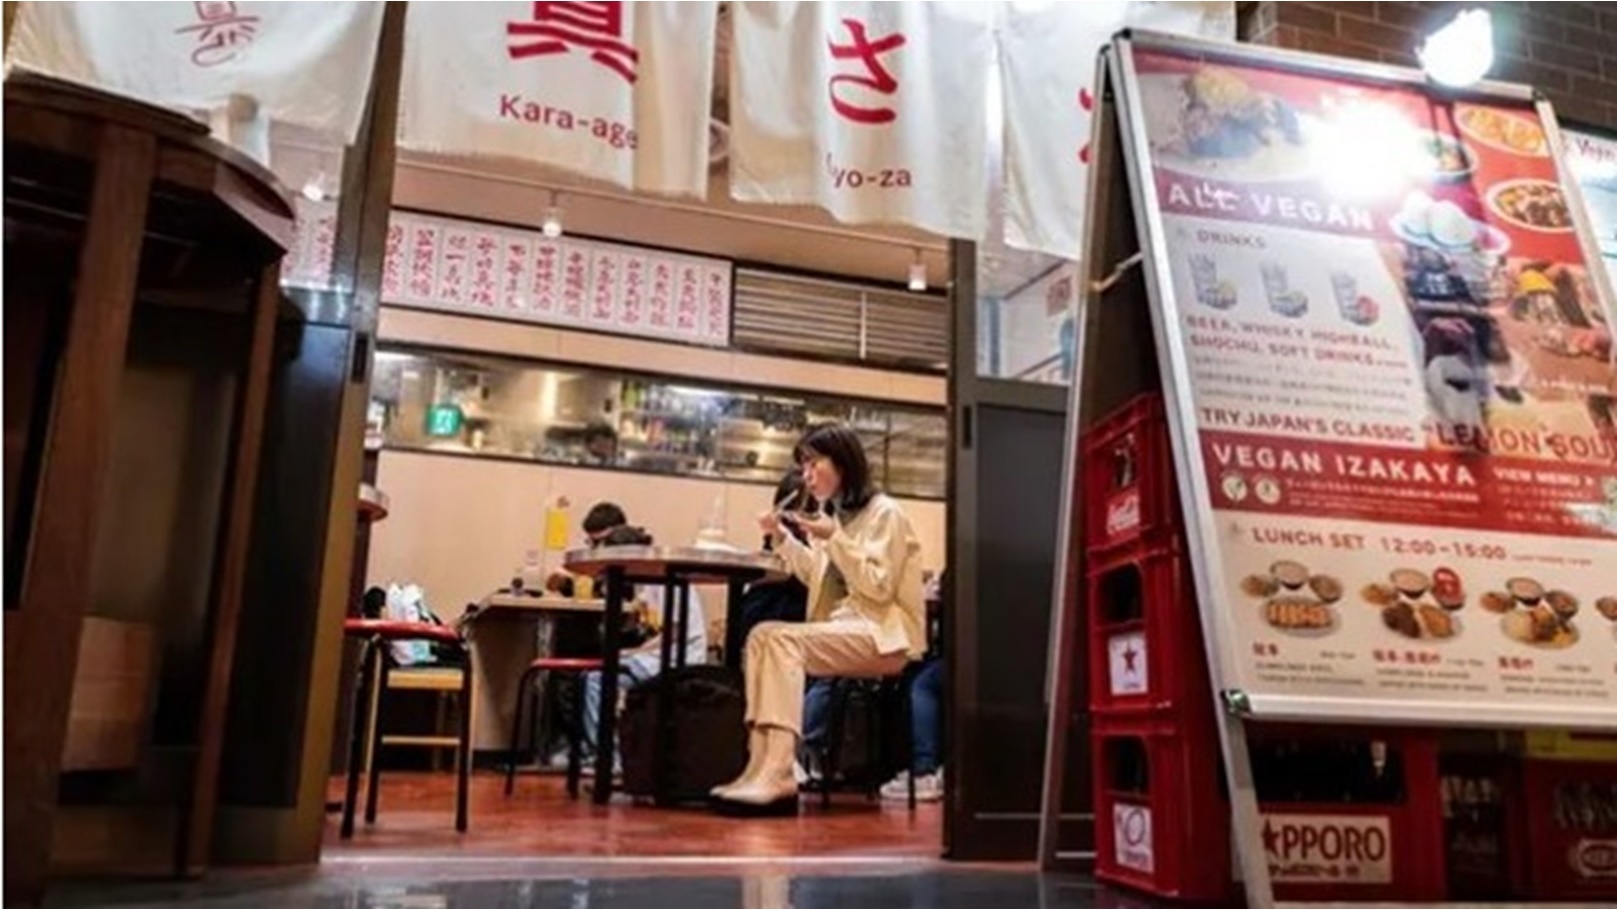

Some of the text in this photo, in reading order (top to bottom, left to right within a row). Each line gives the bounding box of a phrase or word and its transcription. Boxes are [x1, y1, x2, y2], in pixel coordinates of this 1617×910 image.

[828, 18, 906, 125] さ
[500, 94, 637, 150] Kara-age
[829, 157, 912, 189] yo-za
[1169, 184, 1374, 231] ALL VEGAN
[1196, 229, 1267, 249] DRINKS
[1268, 343, 1308, 358] SOFT
[1314, 349, 1374, 366] DRINKS
[1200, 407, 1240, 425] TRY
[1244, 411, 1328, 434] JAPAN'S
[1333, 420, 1415, 442] CLASSIC
[1212, 443, 1476, 487] VEGAN IZAKAYA
[1252, 527, 1323, 547] LUNCH
[1329, 532, 1366, 550] SET
